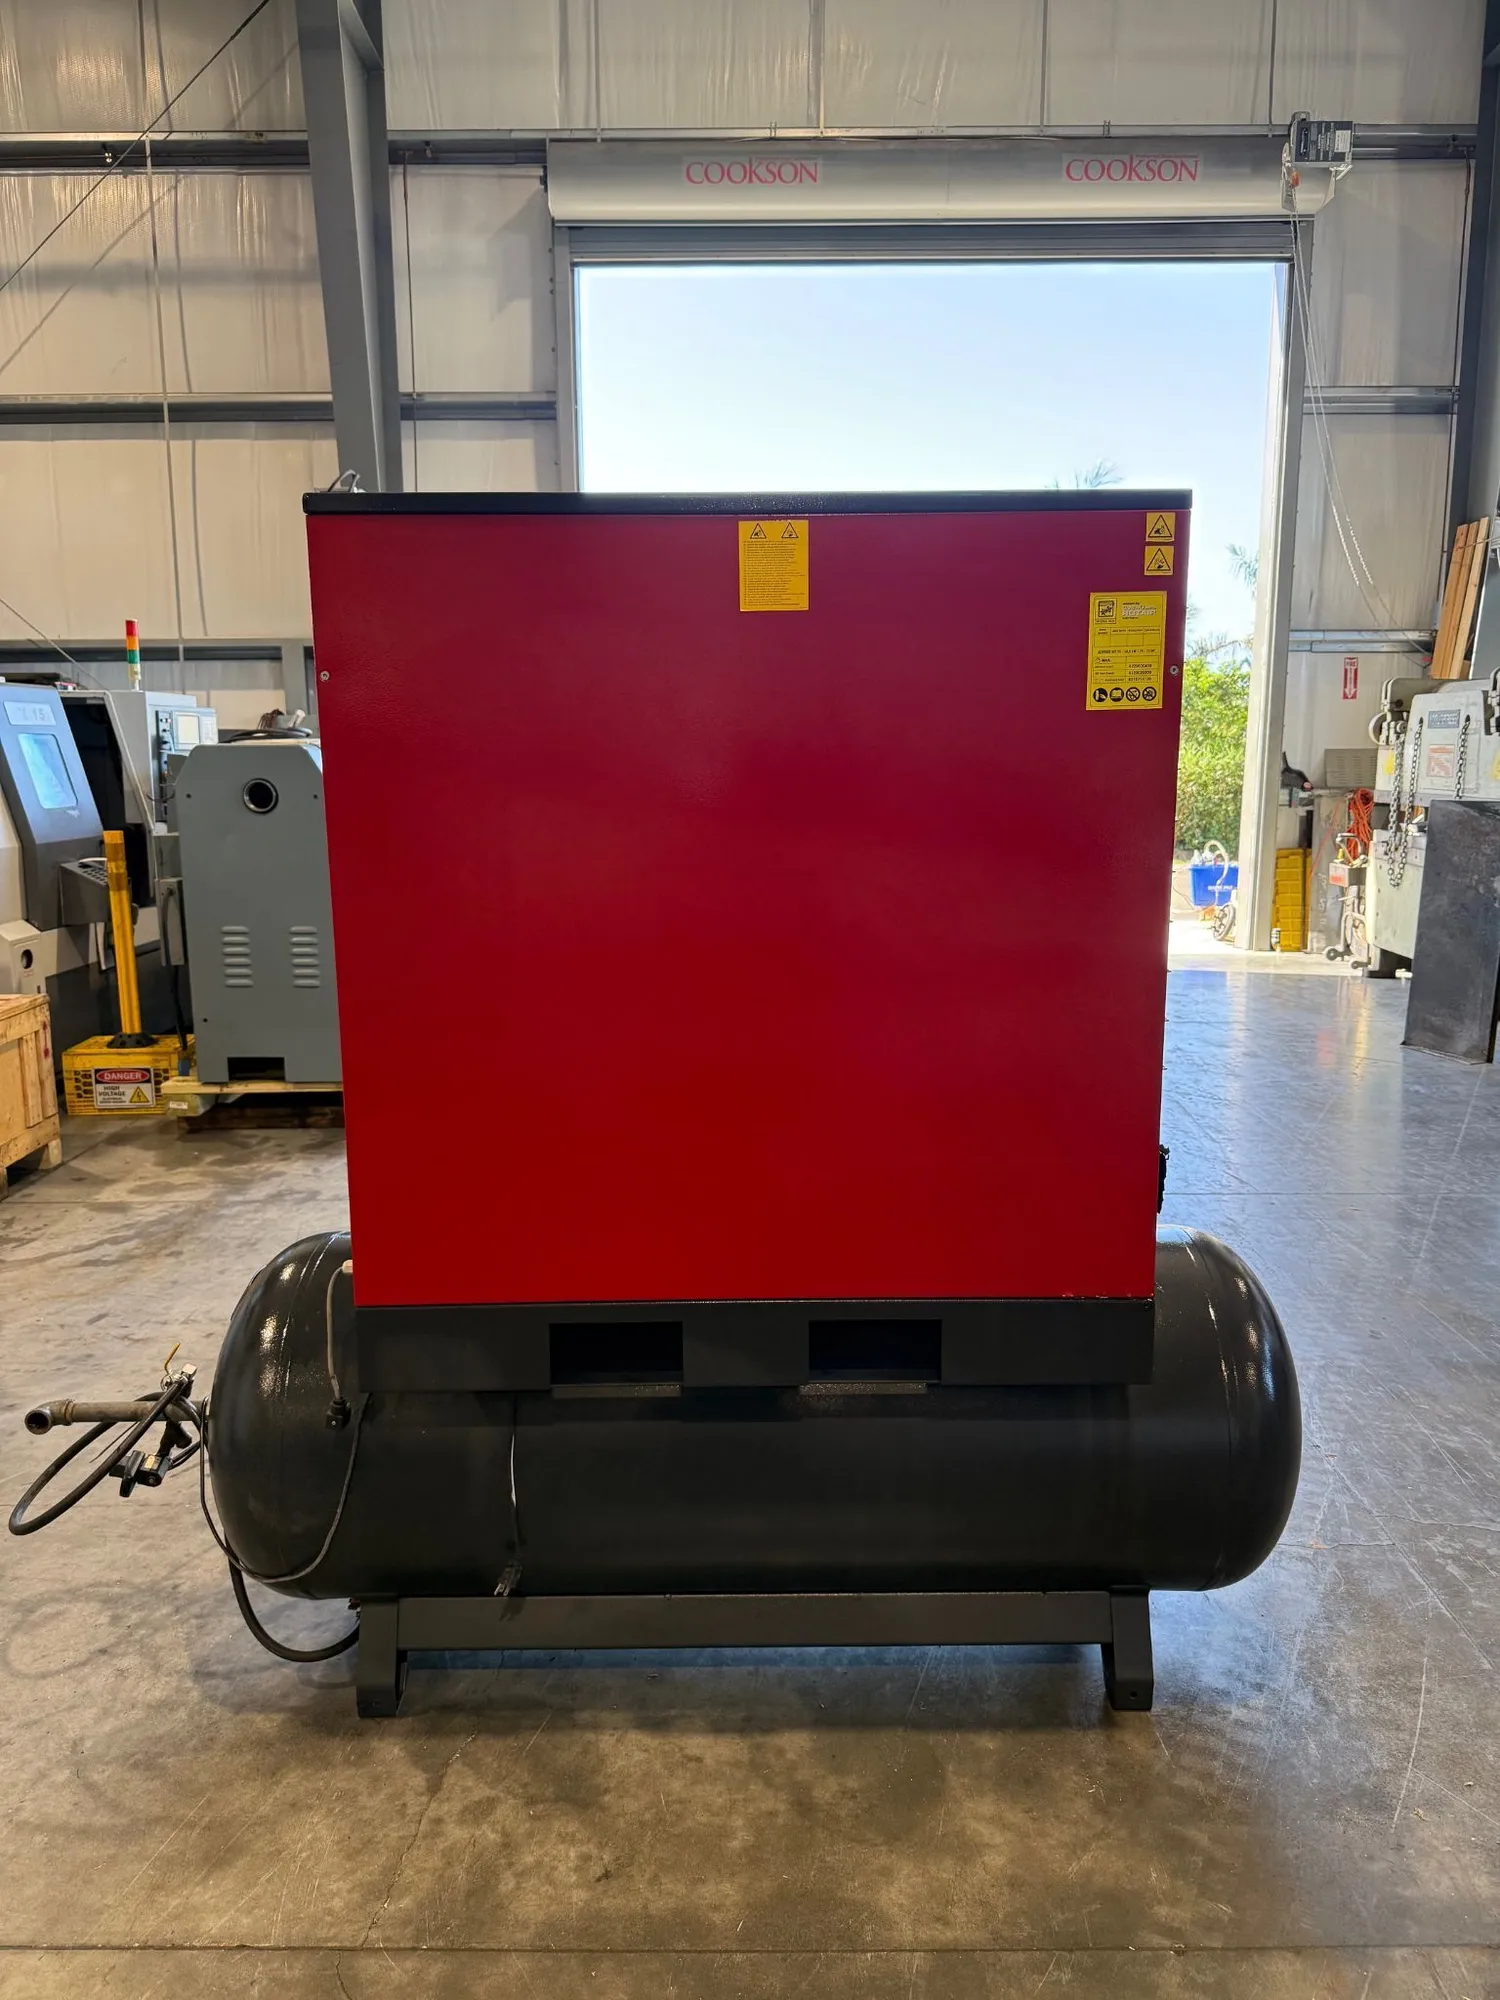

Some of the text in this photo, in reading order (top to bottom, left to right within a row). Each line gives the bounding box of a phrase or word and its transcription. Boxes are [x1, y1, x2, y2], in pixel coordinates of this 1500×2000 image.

[686, 157, 818, 184] COOKSON
[1065, 155, 1199, 182] COOKSON
[104, 1071, 142, 1080] DANGER
